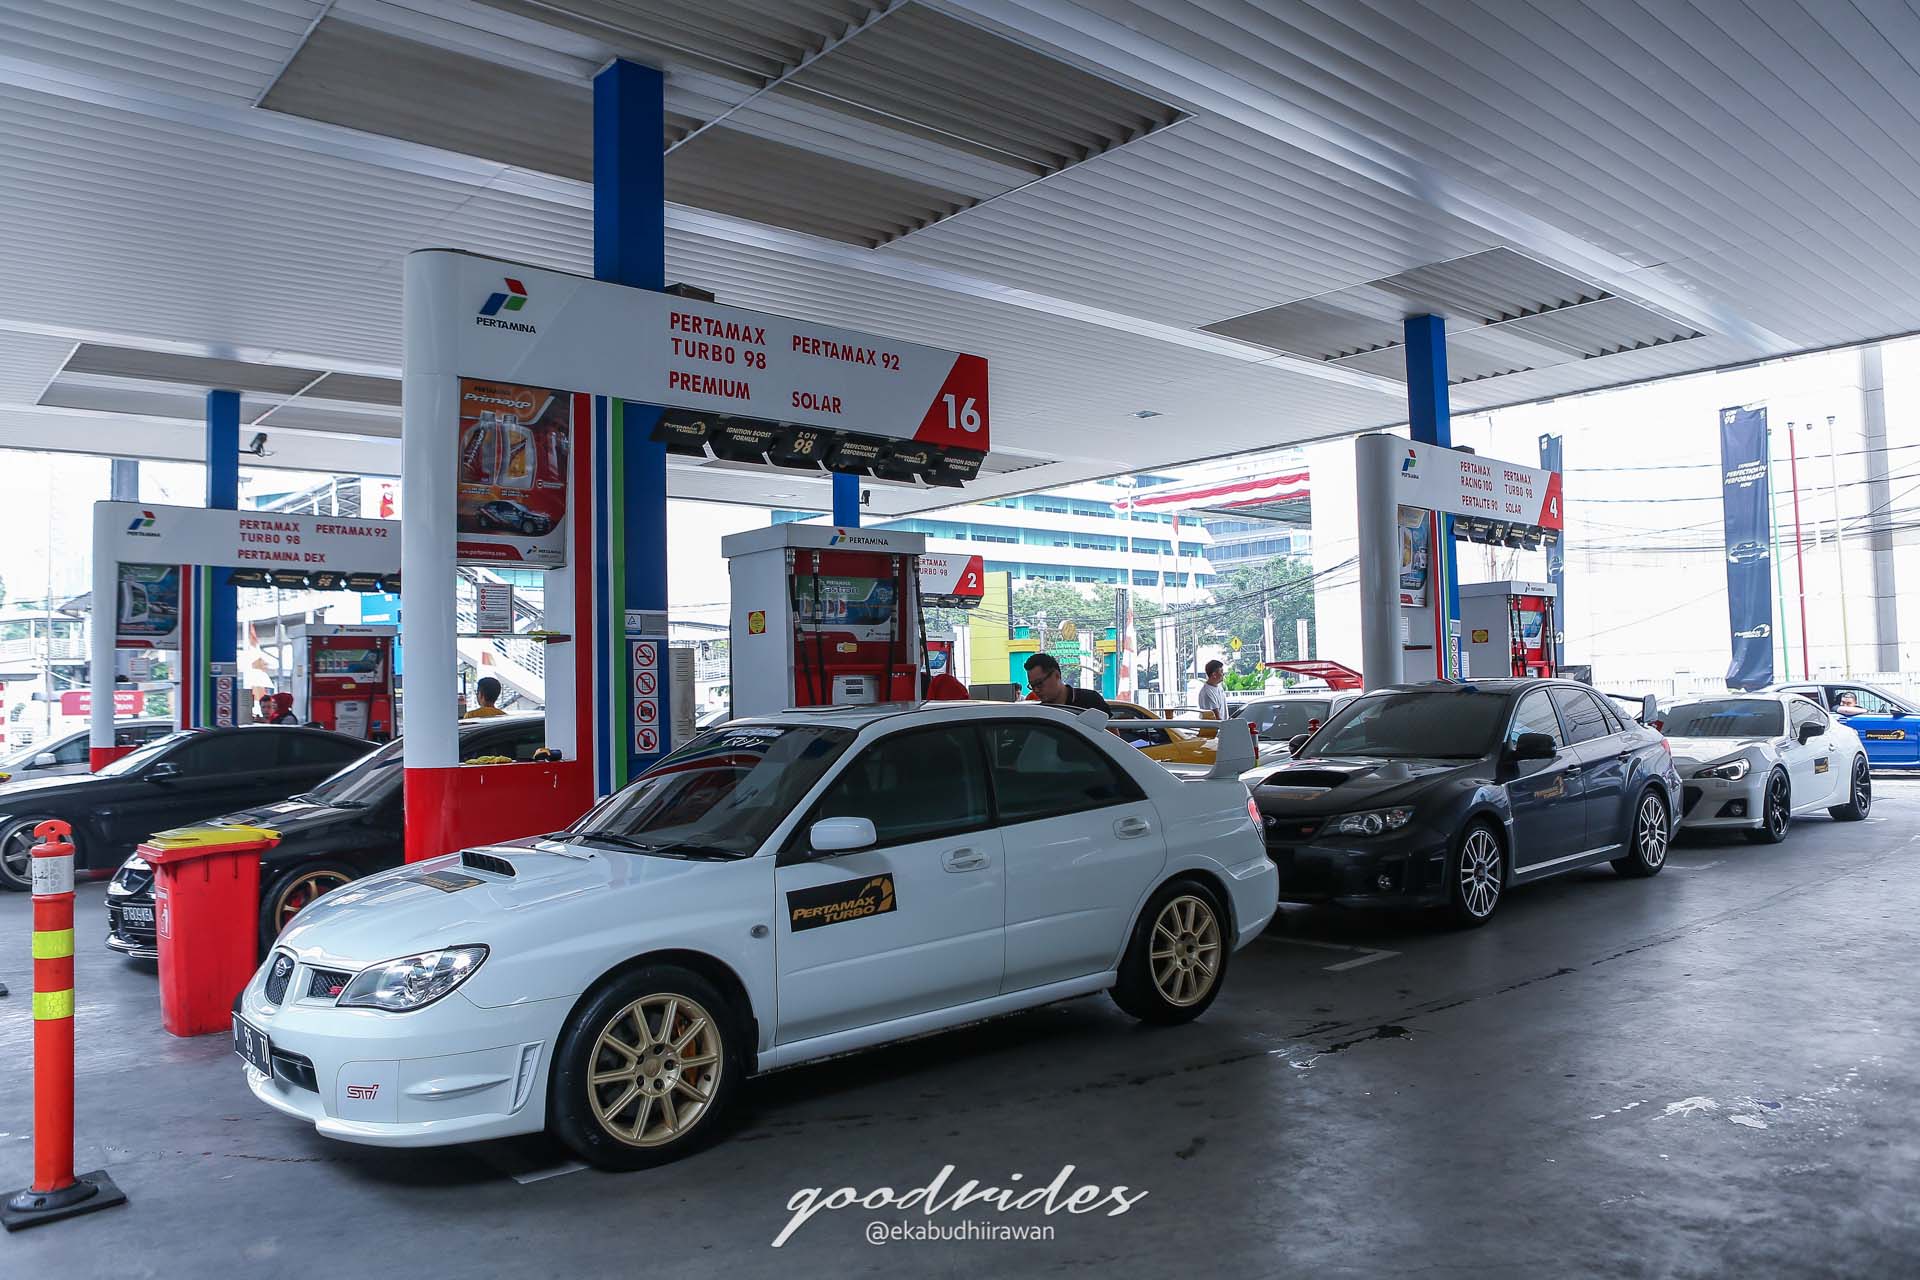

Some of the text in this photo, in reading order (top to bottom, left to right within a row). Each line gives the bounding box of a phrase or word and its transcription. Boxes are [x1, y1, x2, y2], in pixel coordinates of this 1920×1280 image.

[476, 316, 537, 334] PERTAMINA
[670, 311, 766, 346] PERTAMAX
[671, 337, 767, 370] TURBO 98
[792, 334, 901, 371] PERTAMAX 92
[669, 370, 751, 401] PREMIUM
[791, 391, 842, 414] SOLAR
[942, 393, 981, 433] 16
[726, 427, 772, 438] IGNITION BOOST
[732, 435, 759, 443] FORMULA
[792, 438, 814, 455] 98
[840, 448, 877, 459] PERFORMANCE
[1460, 461, 1491, 477] PERTAMAX
[1461, 476, 1493, 492] RACING 100
[1503, 470, 1532, 485] PERTAMAX
[1505, 484, 1533, 499] TURBO 98
[1462, 495, 1498, 511] PERTALITE 90
[1505, 502, 1522, 515] SOLAR
[1549, 496, 1558, 519] 4
[239, 519, 300, 533] PERTAMAX
[315, 523, 388, 538] PERTAMAX 92
[240, 532, 301, 545] TURBO 98
[849, 536, 889, 546] PERTAMINA
[237, 549, 326, 563] PERTAMINA DEX
[919, 558, 947, 567] ERTAMAX
[919, 568, 948, 577] URBO 98
[967, 572, 977, 588] 2
[793, 895, 876, 921] PERTAMAX
[824, 905, 876, 923] TURBO
